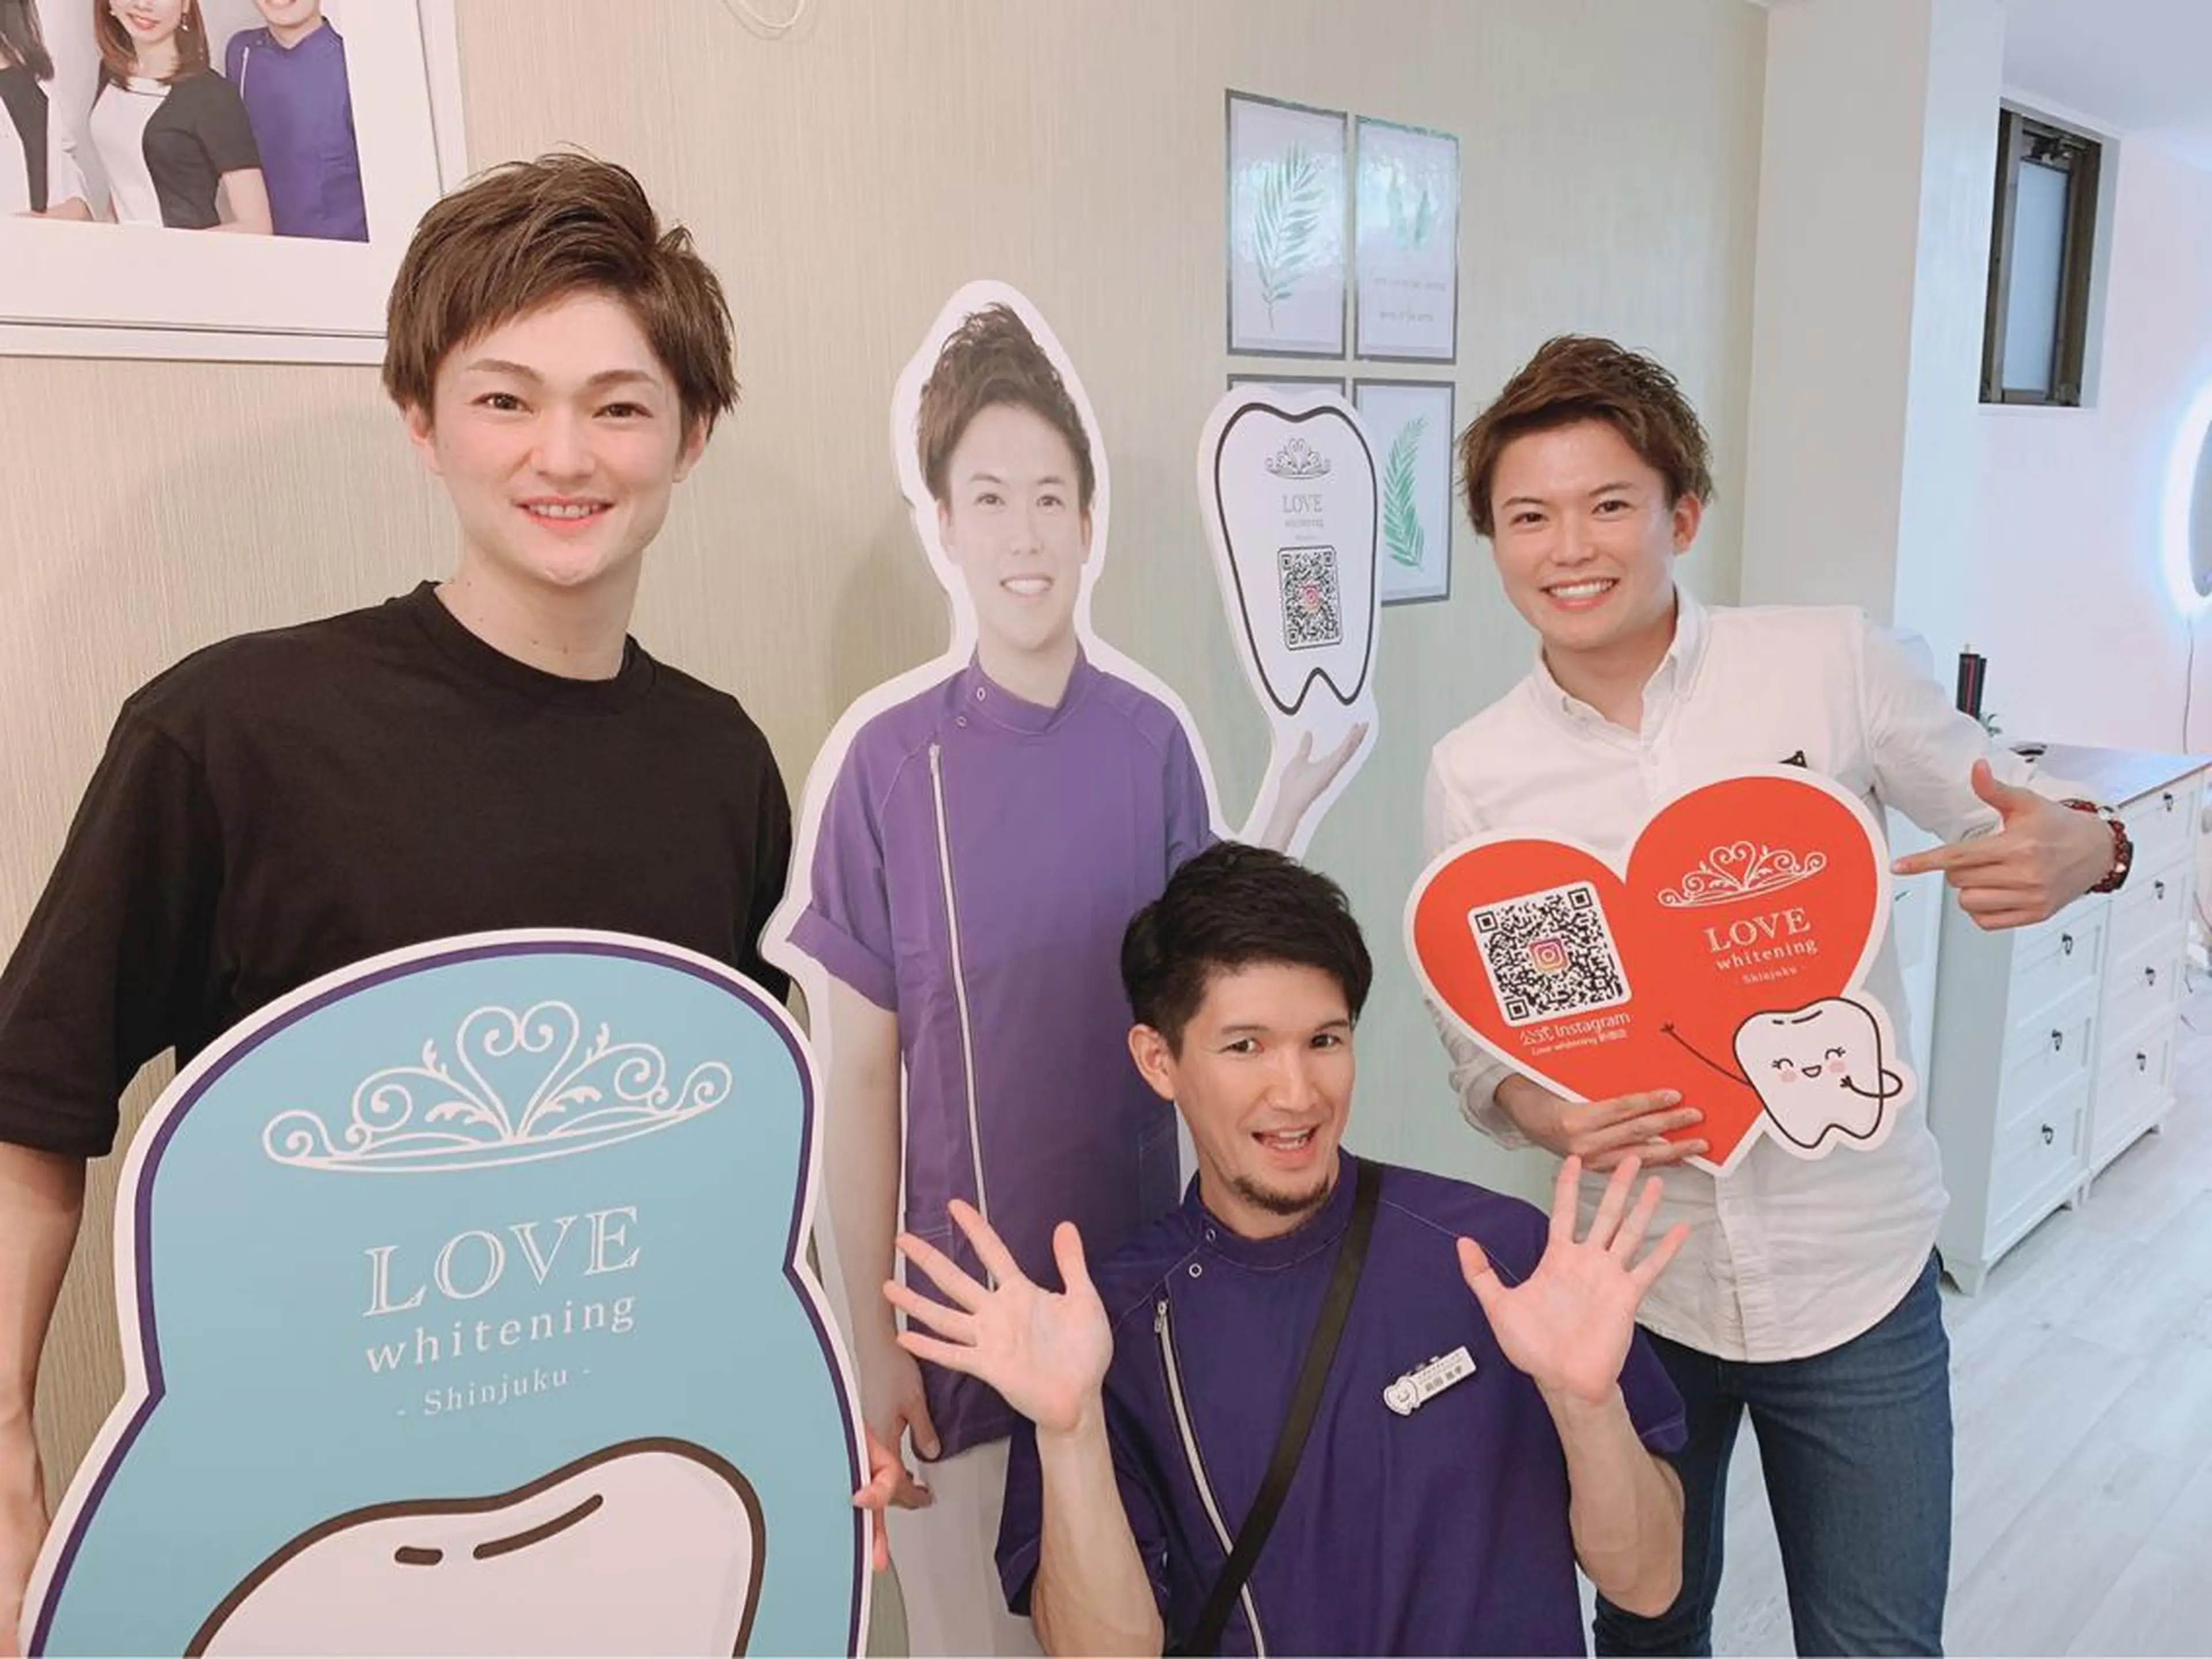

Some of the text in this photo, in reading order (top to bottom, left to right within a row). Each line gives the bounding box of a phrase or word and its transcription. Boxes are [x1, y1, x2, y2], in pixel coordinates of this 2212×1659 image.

[1282, 494, 1323, 513] LOVE
[1702, 908, 1811, 953] LOVE
[1717, 939, 1818, 971] whitening
[1555, 1012, 1631, 1037] Instagram
[362, 1205, 642, 1317] LOVE
[365, 1296, 637, 1373] whitening
[423, 1367, 569, 1415] Shinjuku
